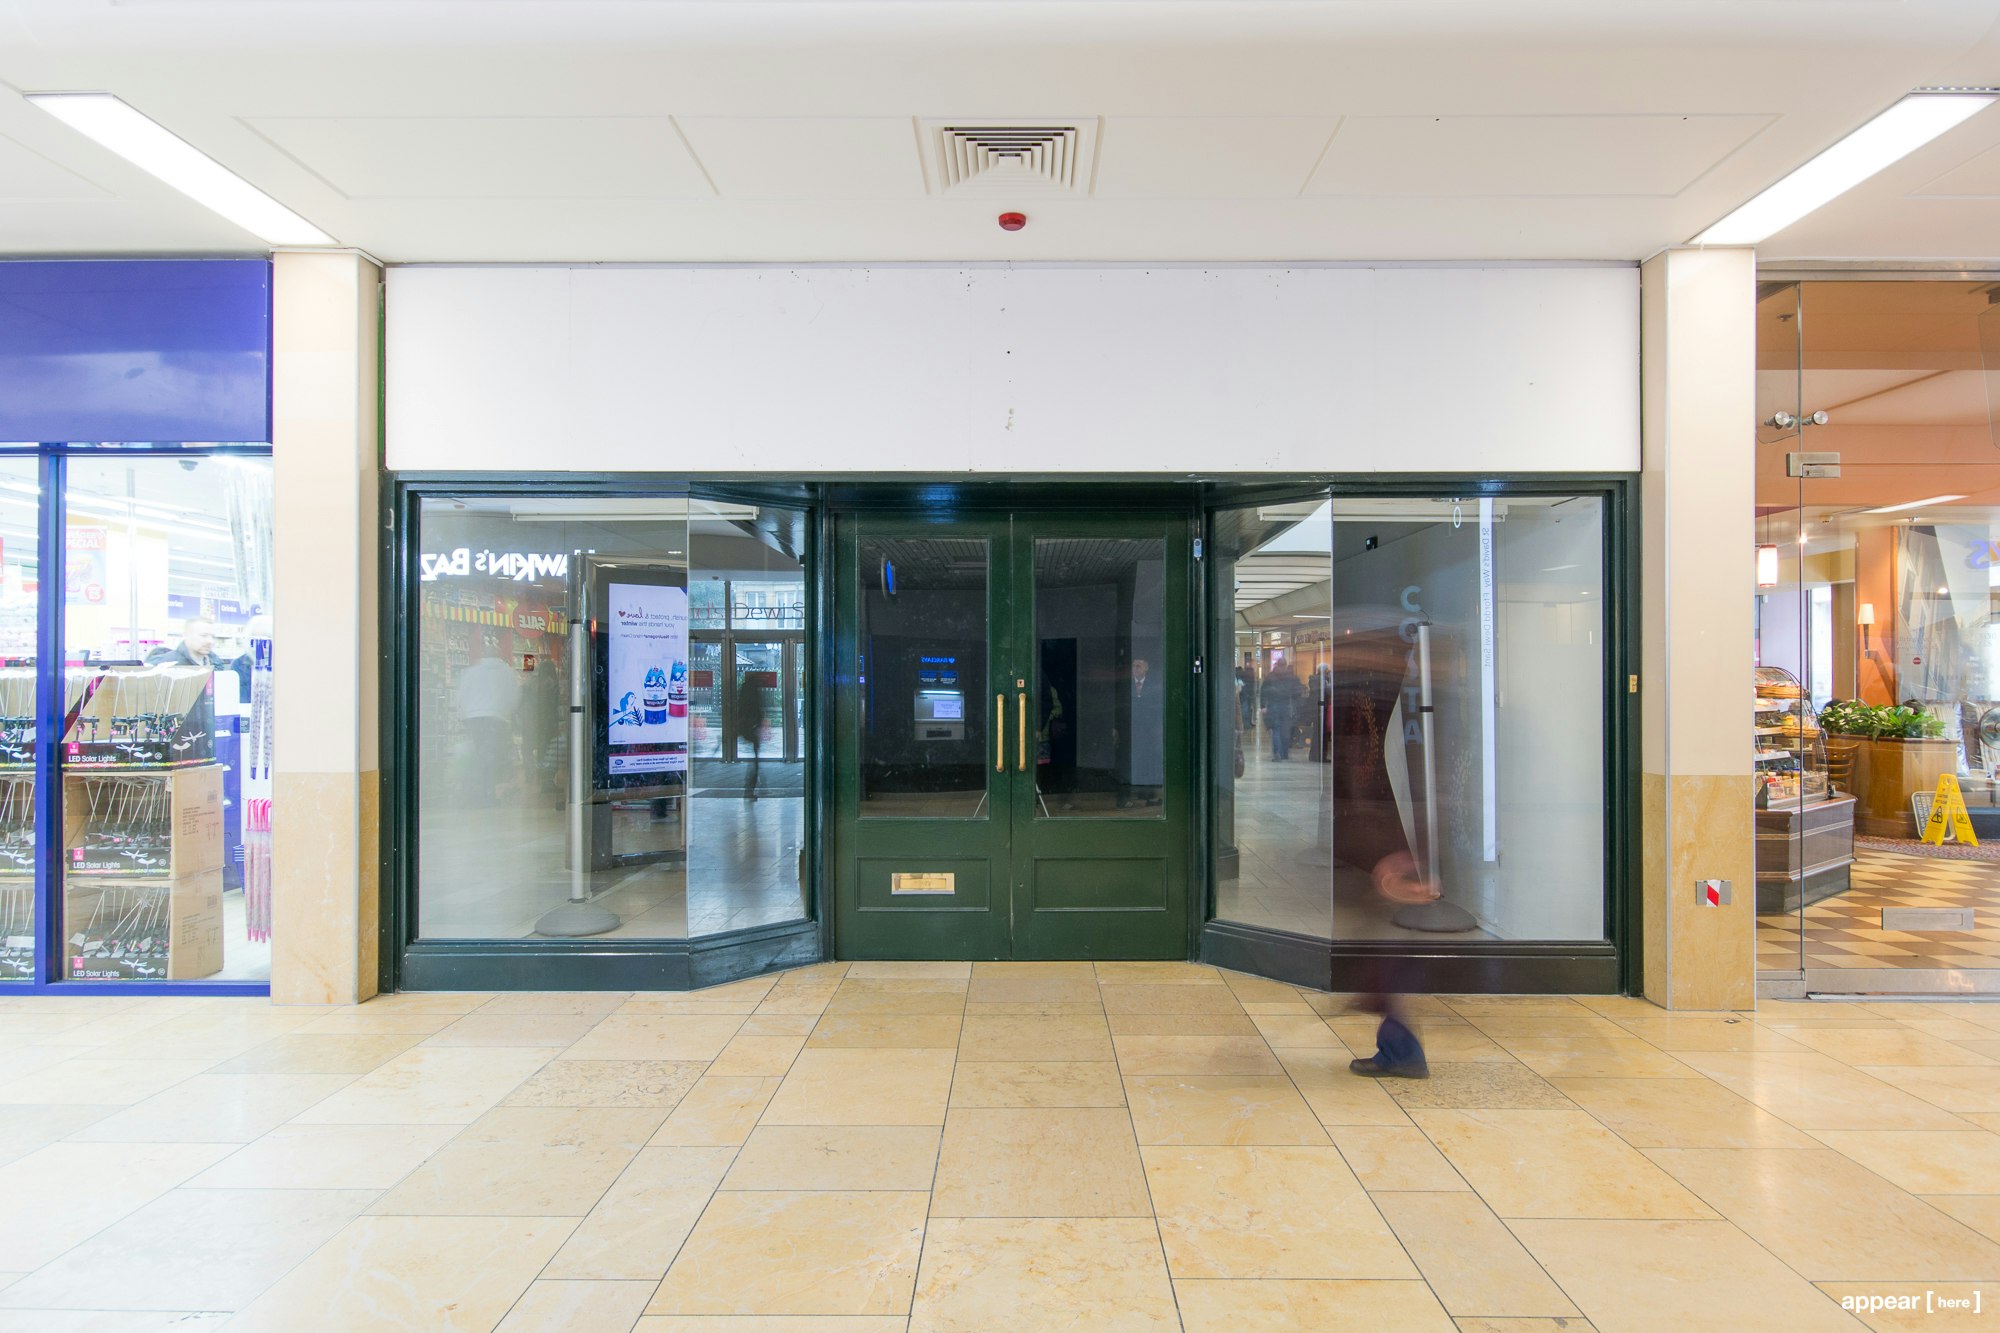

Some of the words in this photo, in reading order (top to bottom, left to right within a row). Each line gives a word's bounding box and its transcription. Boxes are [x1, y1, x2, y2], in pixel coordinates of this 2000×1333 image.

[98, 755, 117, 763] Lights
[102, 862, 120, 870] Lights
[102, 970, 120, 978] Lights
